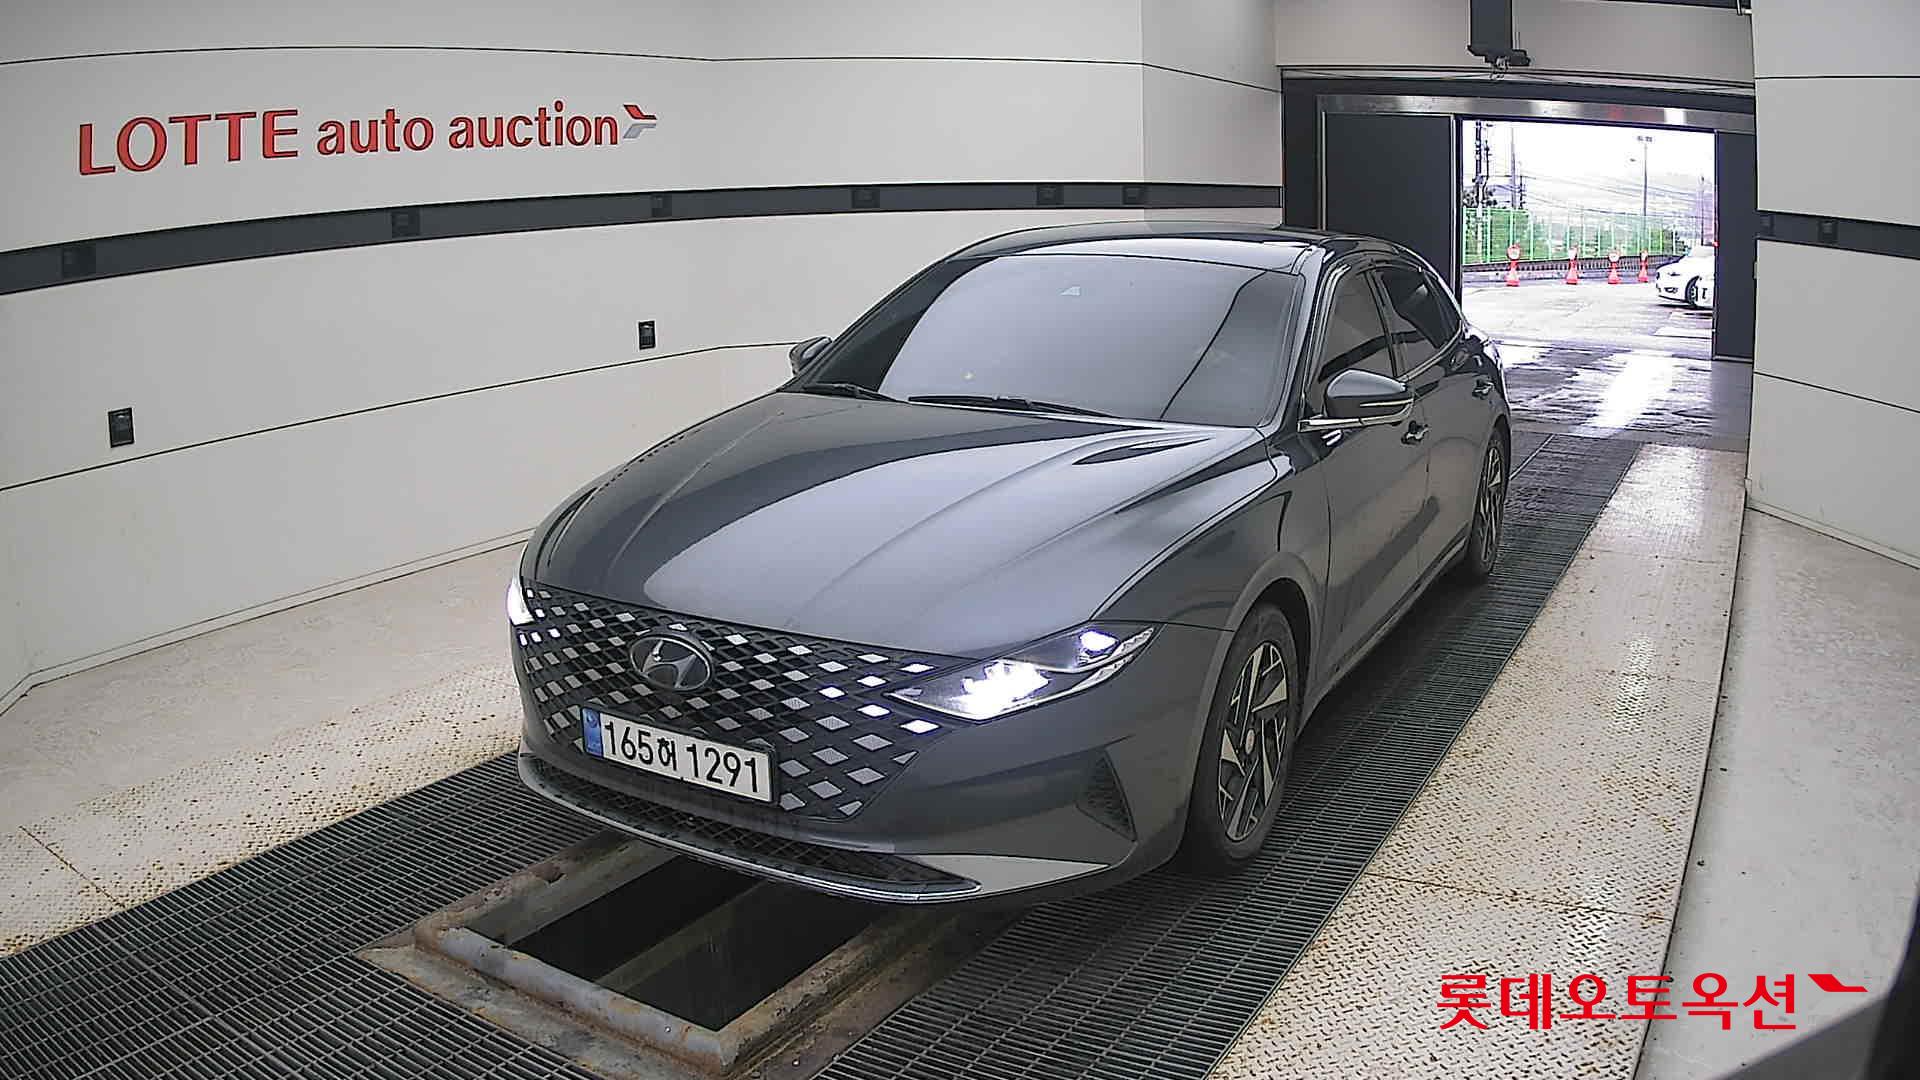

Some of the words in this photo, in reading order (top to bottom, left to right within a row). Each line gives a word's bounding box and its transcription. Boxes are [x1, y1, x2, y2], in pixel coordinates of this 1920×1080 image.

[79, 109, 298, 176] LOTTE
[317, 108, 434, 155] auto
[449, 100, 618, 149] auction
[604, 721, 677, 771] 165허
[686, 743, 759, 793] 1291
